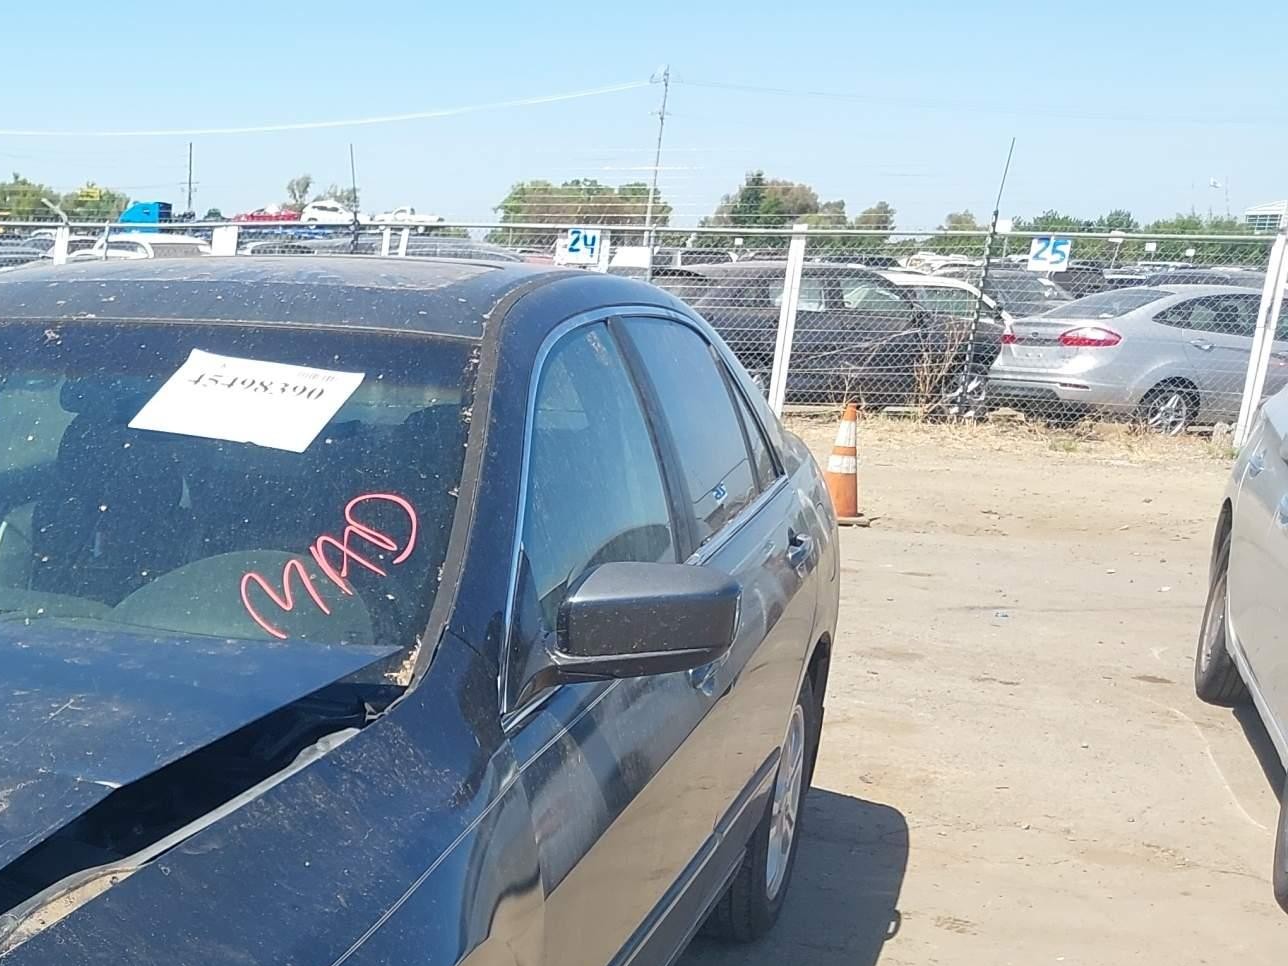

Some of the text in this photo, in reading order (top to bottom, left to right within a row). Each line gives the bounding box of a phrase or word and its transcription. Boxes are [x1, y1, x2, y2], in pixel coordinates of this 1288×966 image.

[568, 230, 596, 258] 24
[1032, 237, 1069, 265] 25
[187, 372, 326, 400] 45498390
[240, 493, 418, 639] MAD
